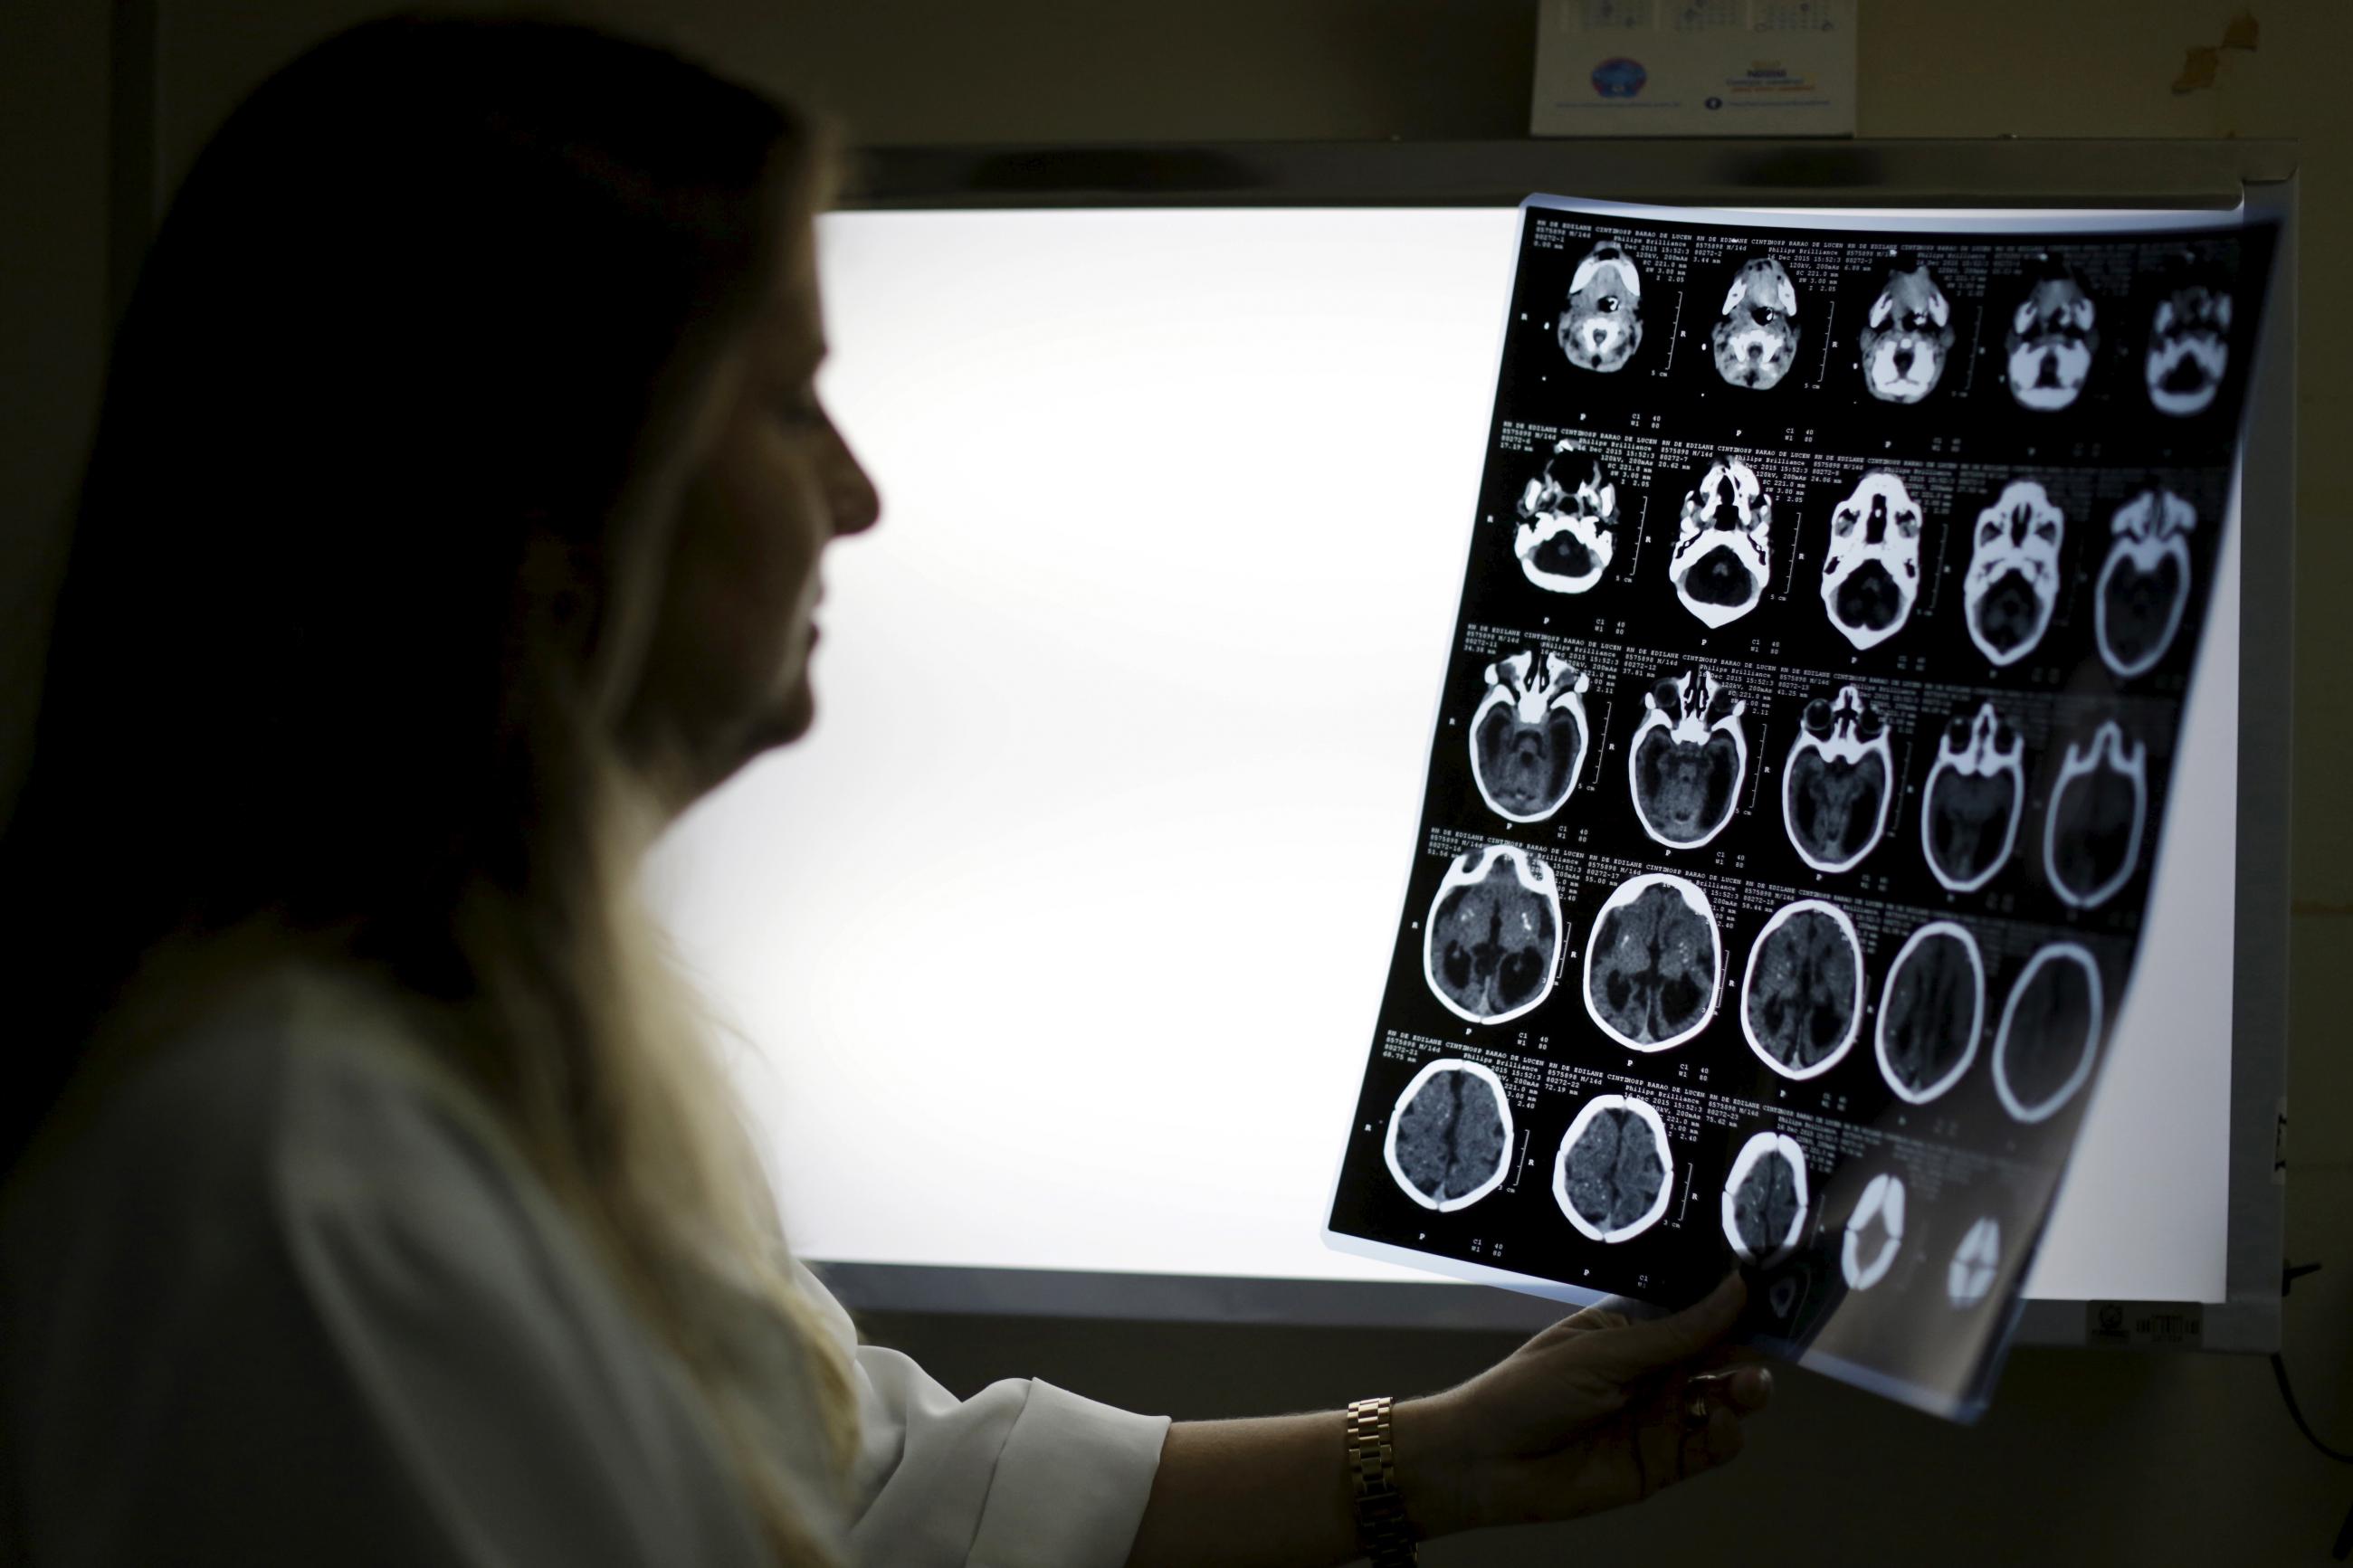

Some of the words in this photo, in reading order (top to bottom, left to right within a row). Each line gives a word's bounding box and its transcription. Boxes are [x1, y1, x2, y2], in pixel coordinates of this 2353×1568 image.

[1646, 238, 1686, 248] Brilliance
[1769, 247, 1796, 255] Philips
[1579, 438, 1607, 448] Philips
[1611, 441, 1652, 452] Brilliance
[1686, 442, 1714, 451] EDILANE
[1661, 447, 1689, 455] 8575898
[1735, 455, 1762, 464] Philips
[1766, 457, 1805, 466] Brilliance
[1492, 627, 1520, 636] EDILANE
[1563, 637, 1584, 646] BARAO
[1541, 641, 1571, 652] Philips
[1574, 646, 1616, 658] Brilliance
[1650, 649, 1679, 659] EDILANE
[1569, 653, 1586, 661] 2015
[1625, 654, 1654, 663] 8575898
[1721, 659, 1741, 667] BARAO
[1756, 663, 1776, 671] LUCEN
[1700, 663, 1728, 674] Philips
[1731, 667, 1771, 678] Brilliance
[1746, 677, 1774, 686] 15:52:3
[1455, 831, 1484, 841] EDILANE
[1526, 843, 1547, 852] BARAO
[1537, 853, 1579, 865] Brilliance
[1613, 858, 1642, 868] EDILANE
[1553, 863, 1582, 873] 15:52:3
[1588, 862, 1617, 872] 8575898
[1685, 870, 1705, 879] BARAO
[1696, 880, 1736, 892] Brilliance
[1711, 889, 1739, 899] 15:52:3
[1413, 1034, 1442, 1045] EDILANE
[1485, 1049, 1507, 1059] BARAO
[1463, 1053, 1493, 1065] Philips
[1496, 1059, 1538, 1072] Brilliance
[1491, 1066, 1508, 1075] 2015
[1548, 1070, 1577, 1081] 8575898
[1574, 1067, 1603, 1078] EDILANE
[1625, 1085, 1654, 1097] Philips
[1658, 1091, 1699, 1104] Brilliance
[1647, 1081, 1668, 1091] BARAO
[1684, 1088, 1705, 1098] LUCEN
[1653, 1098, 1669, 1107] 2015
[1673, 1101, 1702, 1112] 15:52:3
